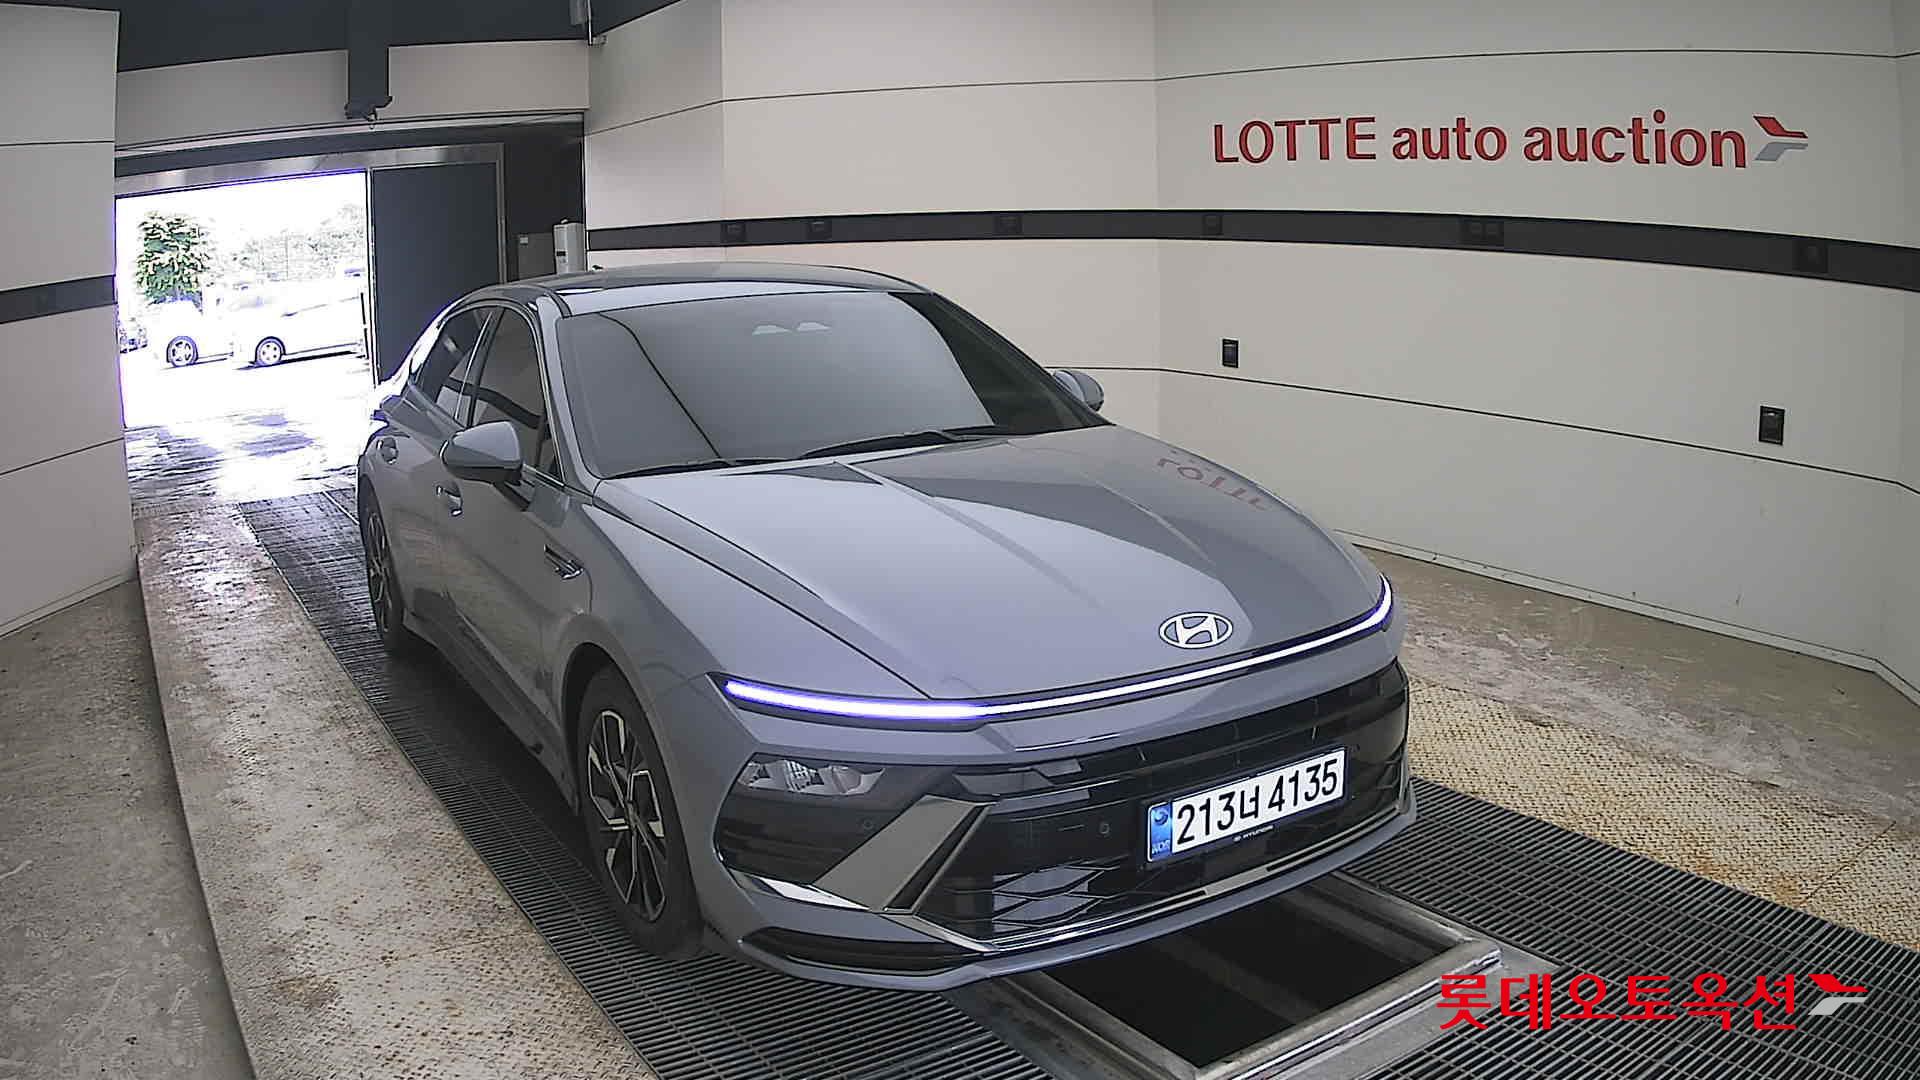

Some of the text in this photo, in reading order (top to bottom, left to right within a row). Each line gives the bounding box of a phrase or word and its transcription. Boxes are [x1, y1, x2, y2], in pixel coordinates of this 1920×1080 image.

[1214, 109, 1747, 168] LOTTE auto auction
[1177, 758, 1338, 845] 213너 4135
